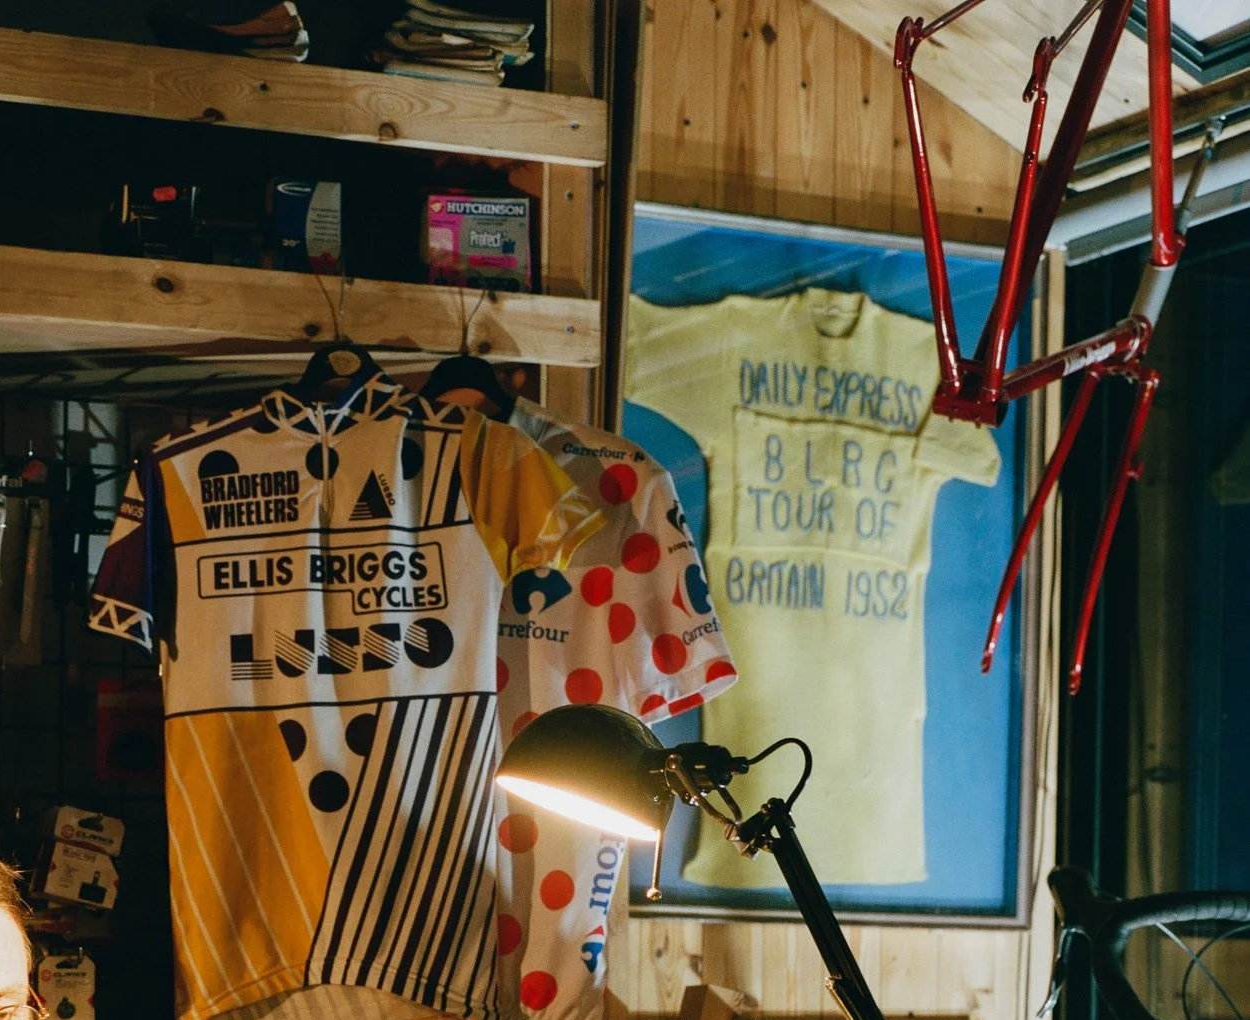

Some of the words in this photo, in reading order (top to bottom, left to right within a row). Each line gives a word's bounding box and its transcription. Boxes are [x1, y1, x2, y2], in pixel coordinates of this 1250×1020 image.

[446, 201, 525, 216] HUTCHINSON
[740, 359, 808, 409] DAILY
[813, 365, 923, 432] EXPRESS
[200, 470, 300, 505] BRADFORD
[377, 473, 396, 507] LUSSO
[203, 496, 300, 531] WHEELERS
[748, 485, 835, 534] TOUR
[856, 497, 900, 542] OF
[213, 555, 294, 591] ELLIS
[309, 550, 429, 585] BRIGGS
[726, 555, 826, 610] BRITAIN
[844, 569, 909, 620] 1952
[356, 584, 443, 610] CYCLES
[229, 616, 455, 682] LUSSO
